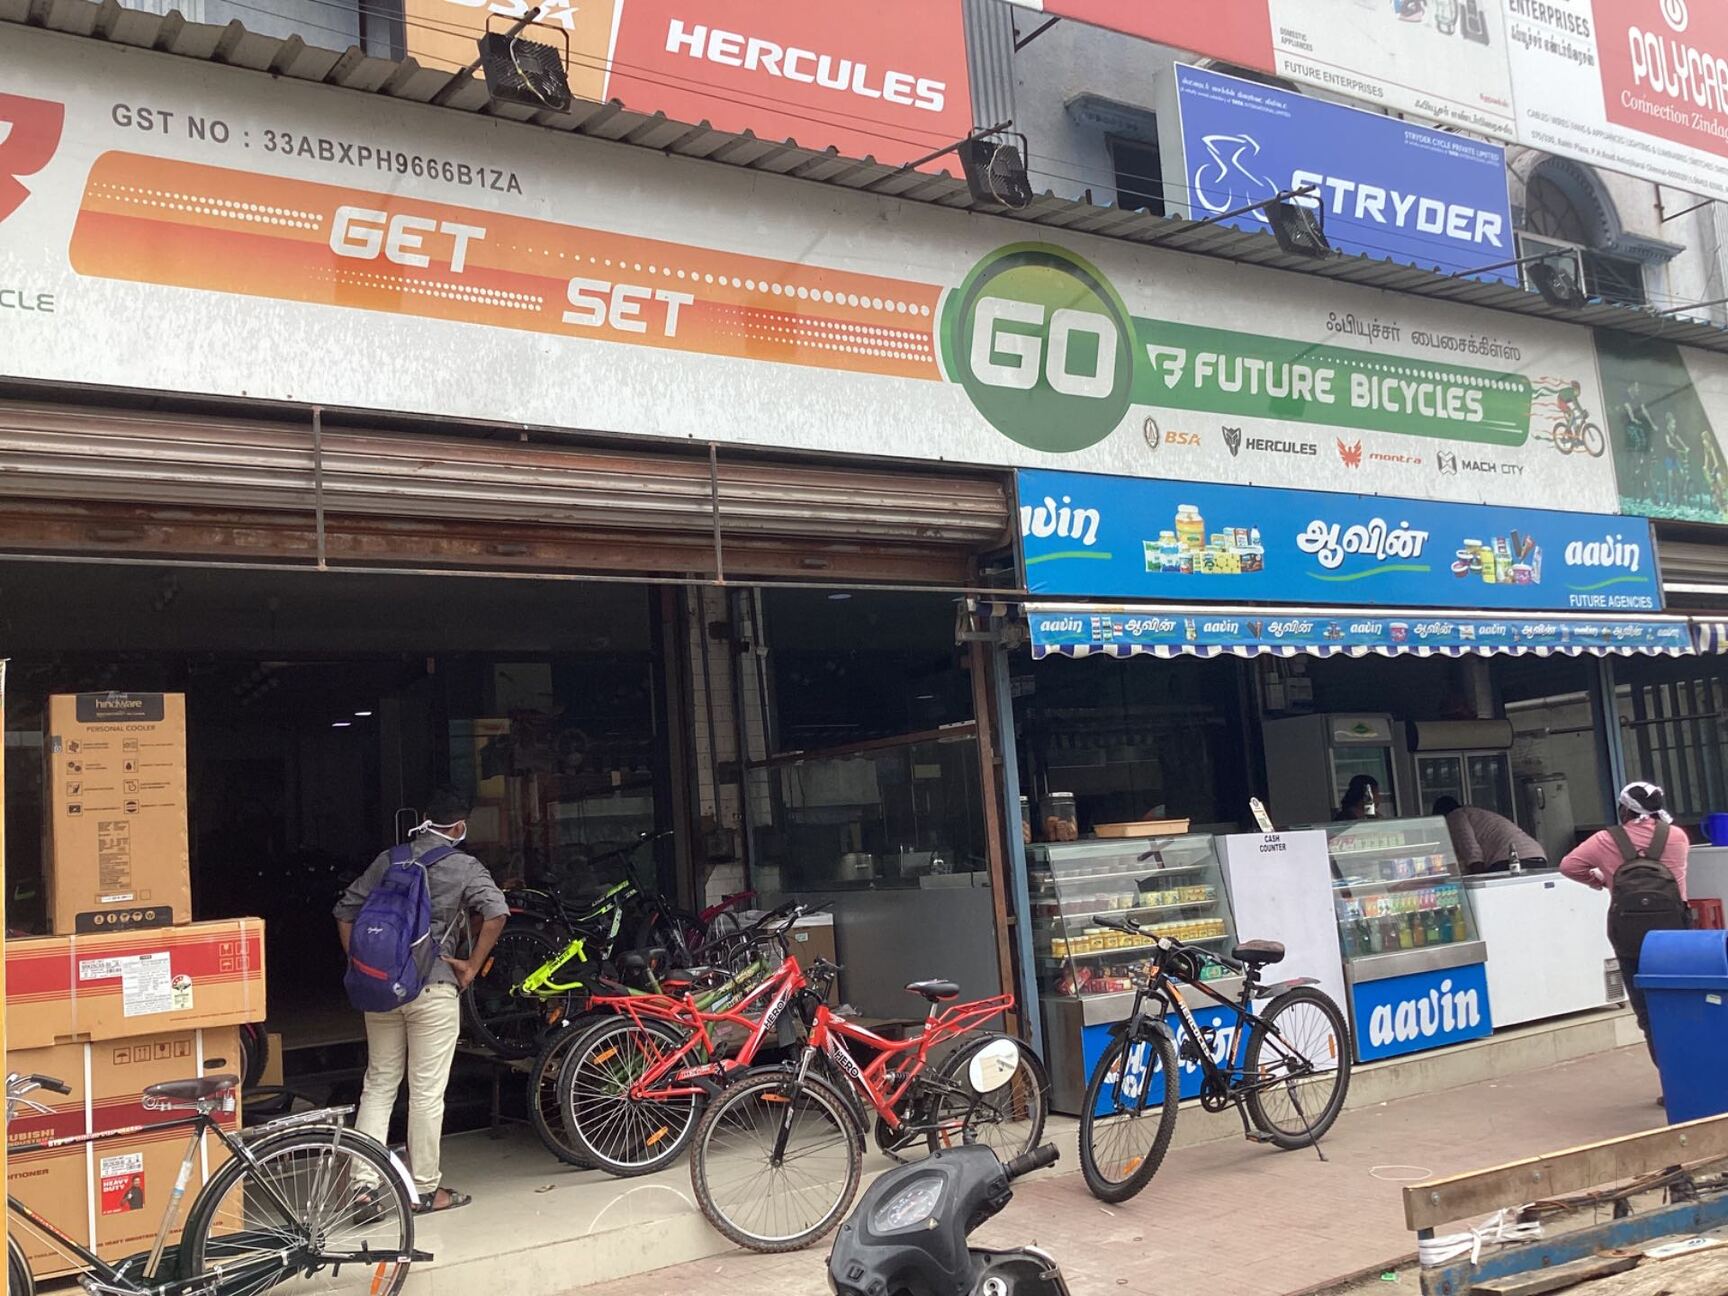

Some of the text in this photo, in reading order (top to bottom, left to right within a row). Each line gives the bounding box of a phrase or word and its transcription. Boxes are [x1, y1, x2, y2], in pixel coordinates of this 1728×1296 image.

[665, 19, 948, 112] HERCULES
[1284, 61, 1384, 98] FUTURE ENTERPRISES
[1621, 90, 1689, 126] Connection
[111, 102, 174, 134] GST
[188, 115, 231, 144] NO
[263, 129, 524, 195] 33ABXPH9666B1ZA
[1432, 138, 1450, 149] CYCLE
[1452, 143, 1475, 155] PRIVATE
[1288, 171, 1504, 248] STRYDER
[328, 205, 487, 273] GET
[562, 276, 695, 338] SET
[968, 296, 1118, 399] GO
[1194, 352, 1484, 422] FUTURE BICYCLES
[1164, 430, 1201, 447] BSA
[1246, 438, 1317, 456] HERCULES
[1370, 451, 1422, 465] montra
[1462, 460, 1524, 475] MACH CITY
[1296, 516, 1429, 570] ஆவின்
[1564, 533, 1640, 572] aavin
[1569, 595, 1653, 608] FUTURE AGENCIES
[1040, 617, 1083, 633] aavin
[1125, 618, 1176, 636] ஆவின்
[1203, 618, 1239, 634] aavin
[1268, 619, 1314, 638] ஆவின்
[1350, 622, 1382, 635] aavin
[1414, 622, 1454, 639] ஆவின்
[95, 698, 142, 709] hindware
[86, 725, 124, 733] PERSONAL
[1264, 834, 1280, 843] CASH
[1259, 843, 1286, 853] COUNTER
[763, 1000, 785, 1031] HERO
[1369, 978, 1480, 1048] aavin
[833, 1049, 859, 1078] HERO
[103, 1178, 128, 1188] HEAVY
[103, 1184, 125, 1193] DUTY
